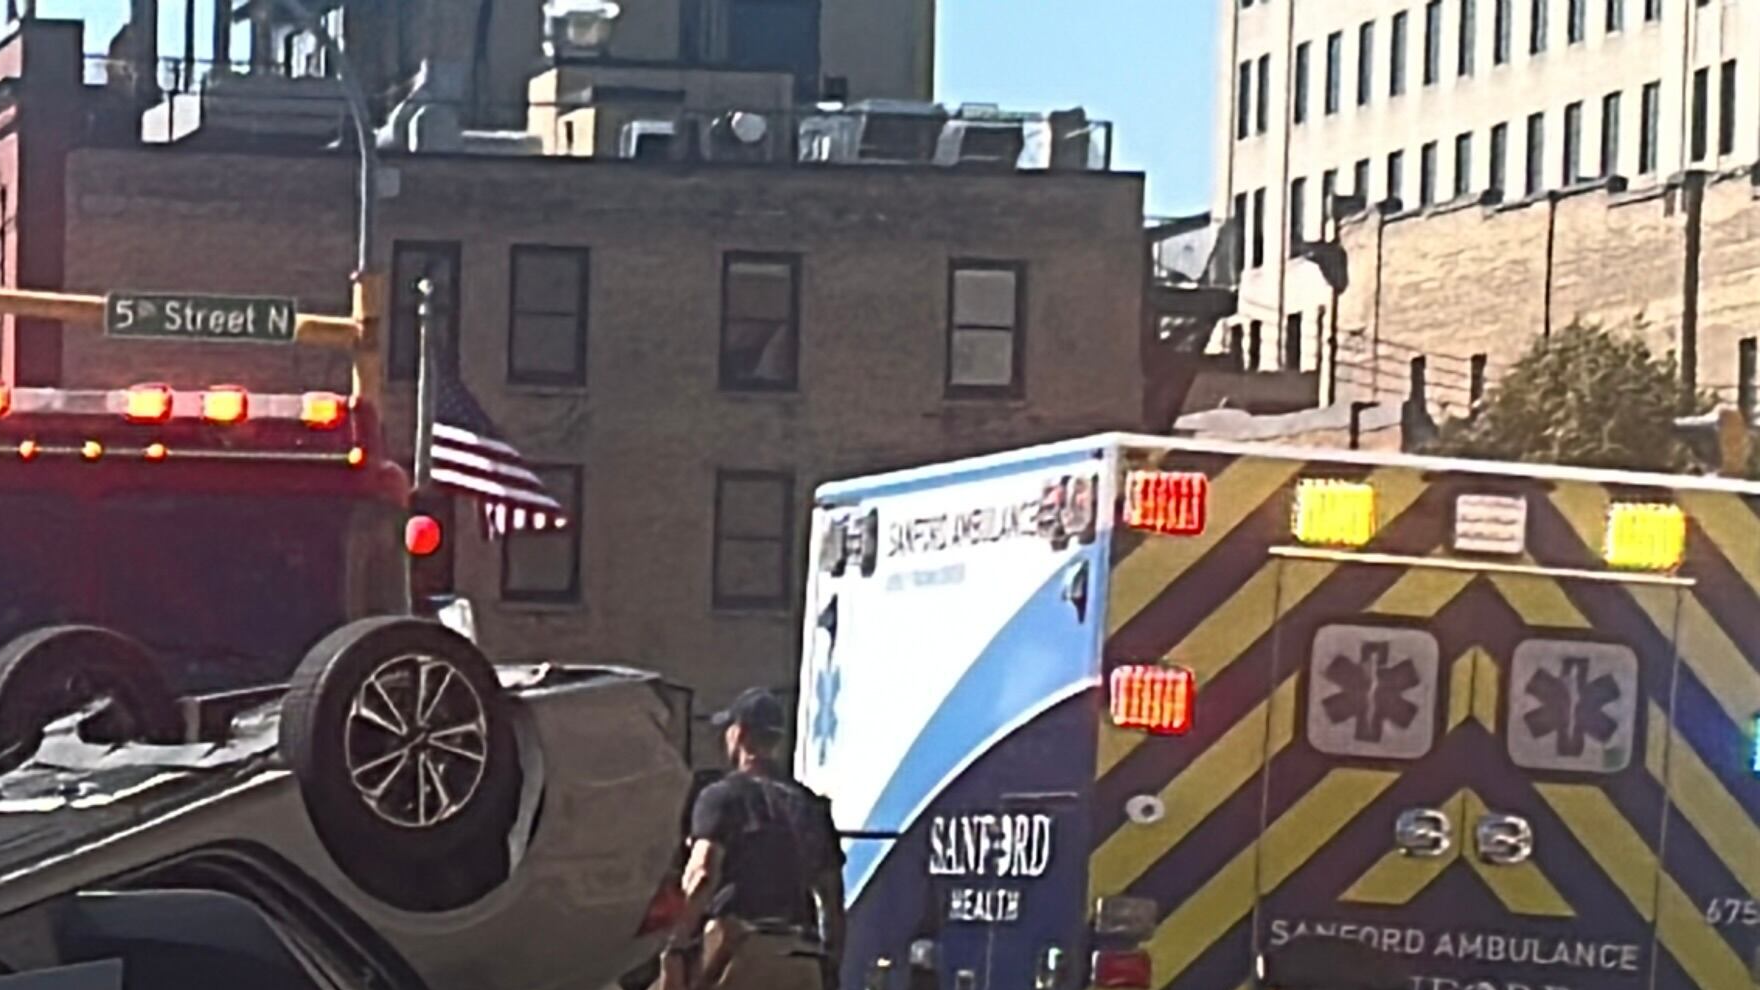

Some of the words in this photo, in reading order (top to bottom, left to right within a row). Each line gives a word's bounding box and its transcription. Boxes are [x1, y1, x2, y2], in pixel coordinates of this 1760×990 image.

[164, 301, 255, 334] Street
[268, 306, 288, 335] N
[929, 814, 1051, 876] SANFORD
[949, 888, 1020, 921] HEALTH
[1433, 932, 1640, 972] AMBULANCE
